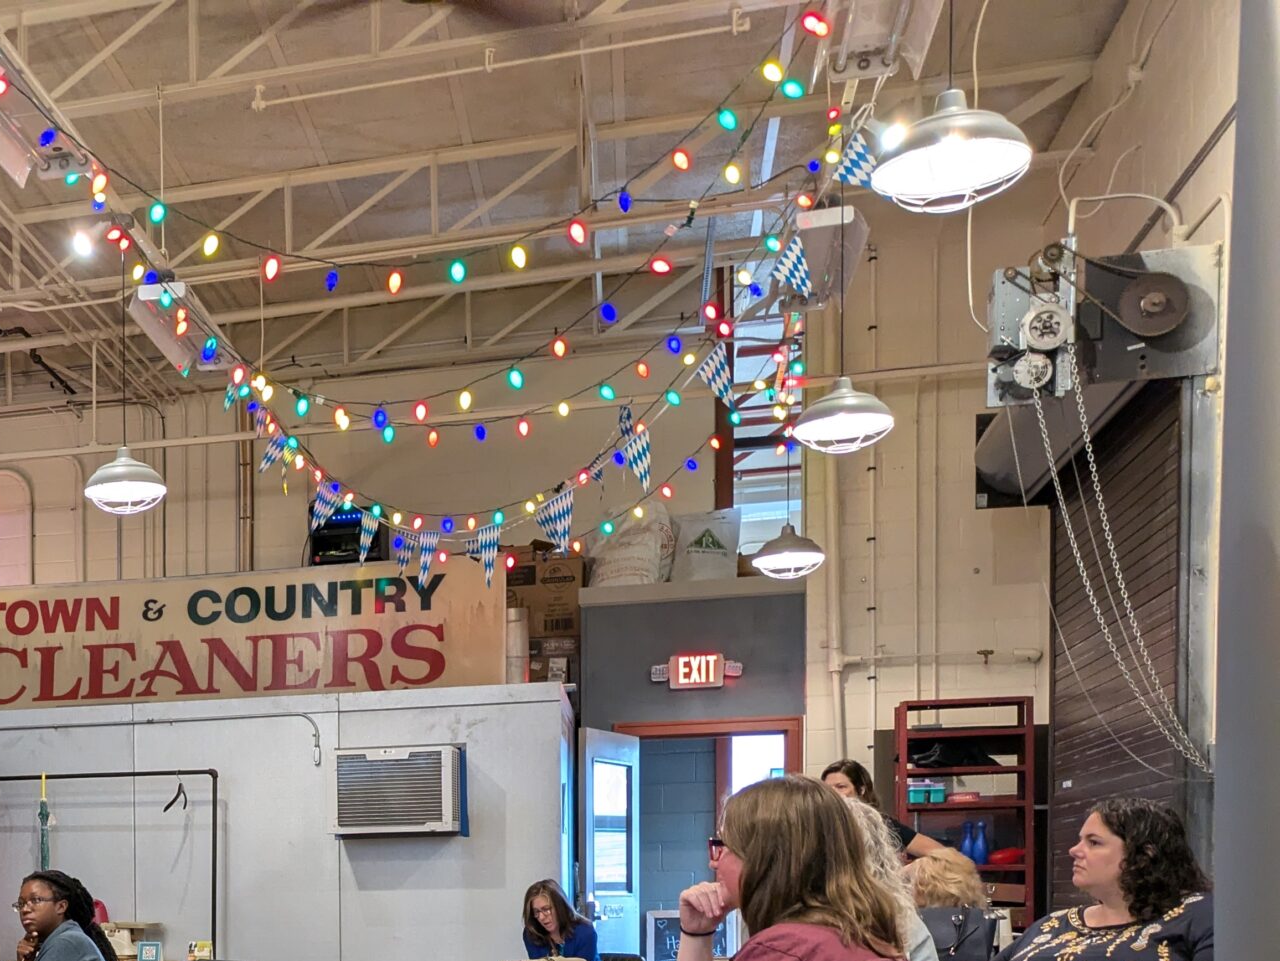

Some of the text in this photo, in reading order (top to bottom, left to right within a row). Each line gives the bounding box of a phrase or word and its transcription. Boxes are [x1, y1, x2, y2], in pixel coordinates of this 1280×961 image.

[142, 599, 167, 622] &
[187, 574, 446, 625] COUNTRY
[678, 655, 717, 684] EXIT
